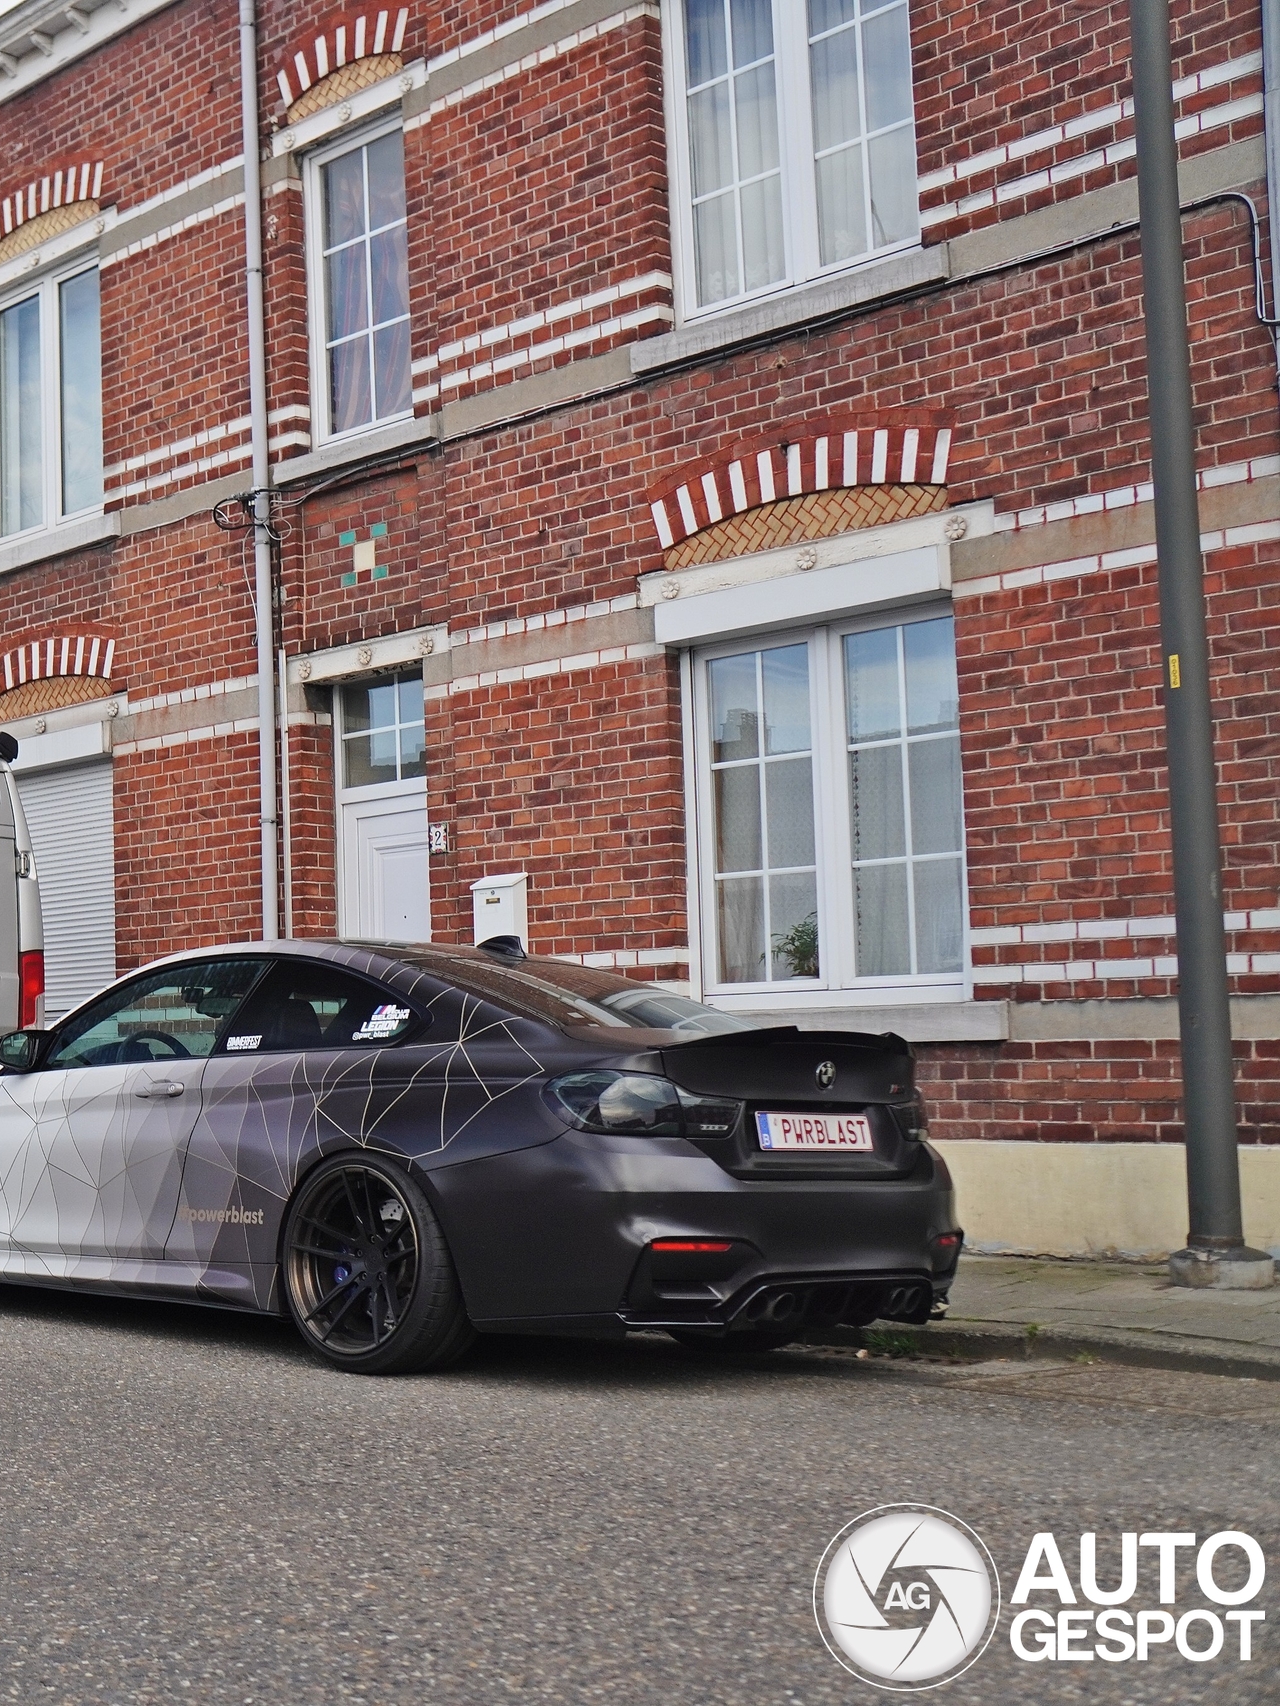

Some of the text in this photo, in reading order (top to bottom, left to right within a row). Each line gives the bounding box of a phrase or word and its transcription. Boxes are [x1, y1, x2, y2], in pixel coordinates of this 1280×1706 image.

[434, 830, 442, 846] 2
[360, 1020, 400, 1033] LEGION
[781, 1118, 866, 1145] PWRBLAST
